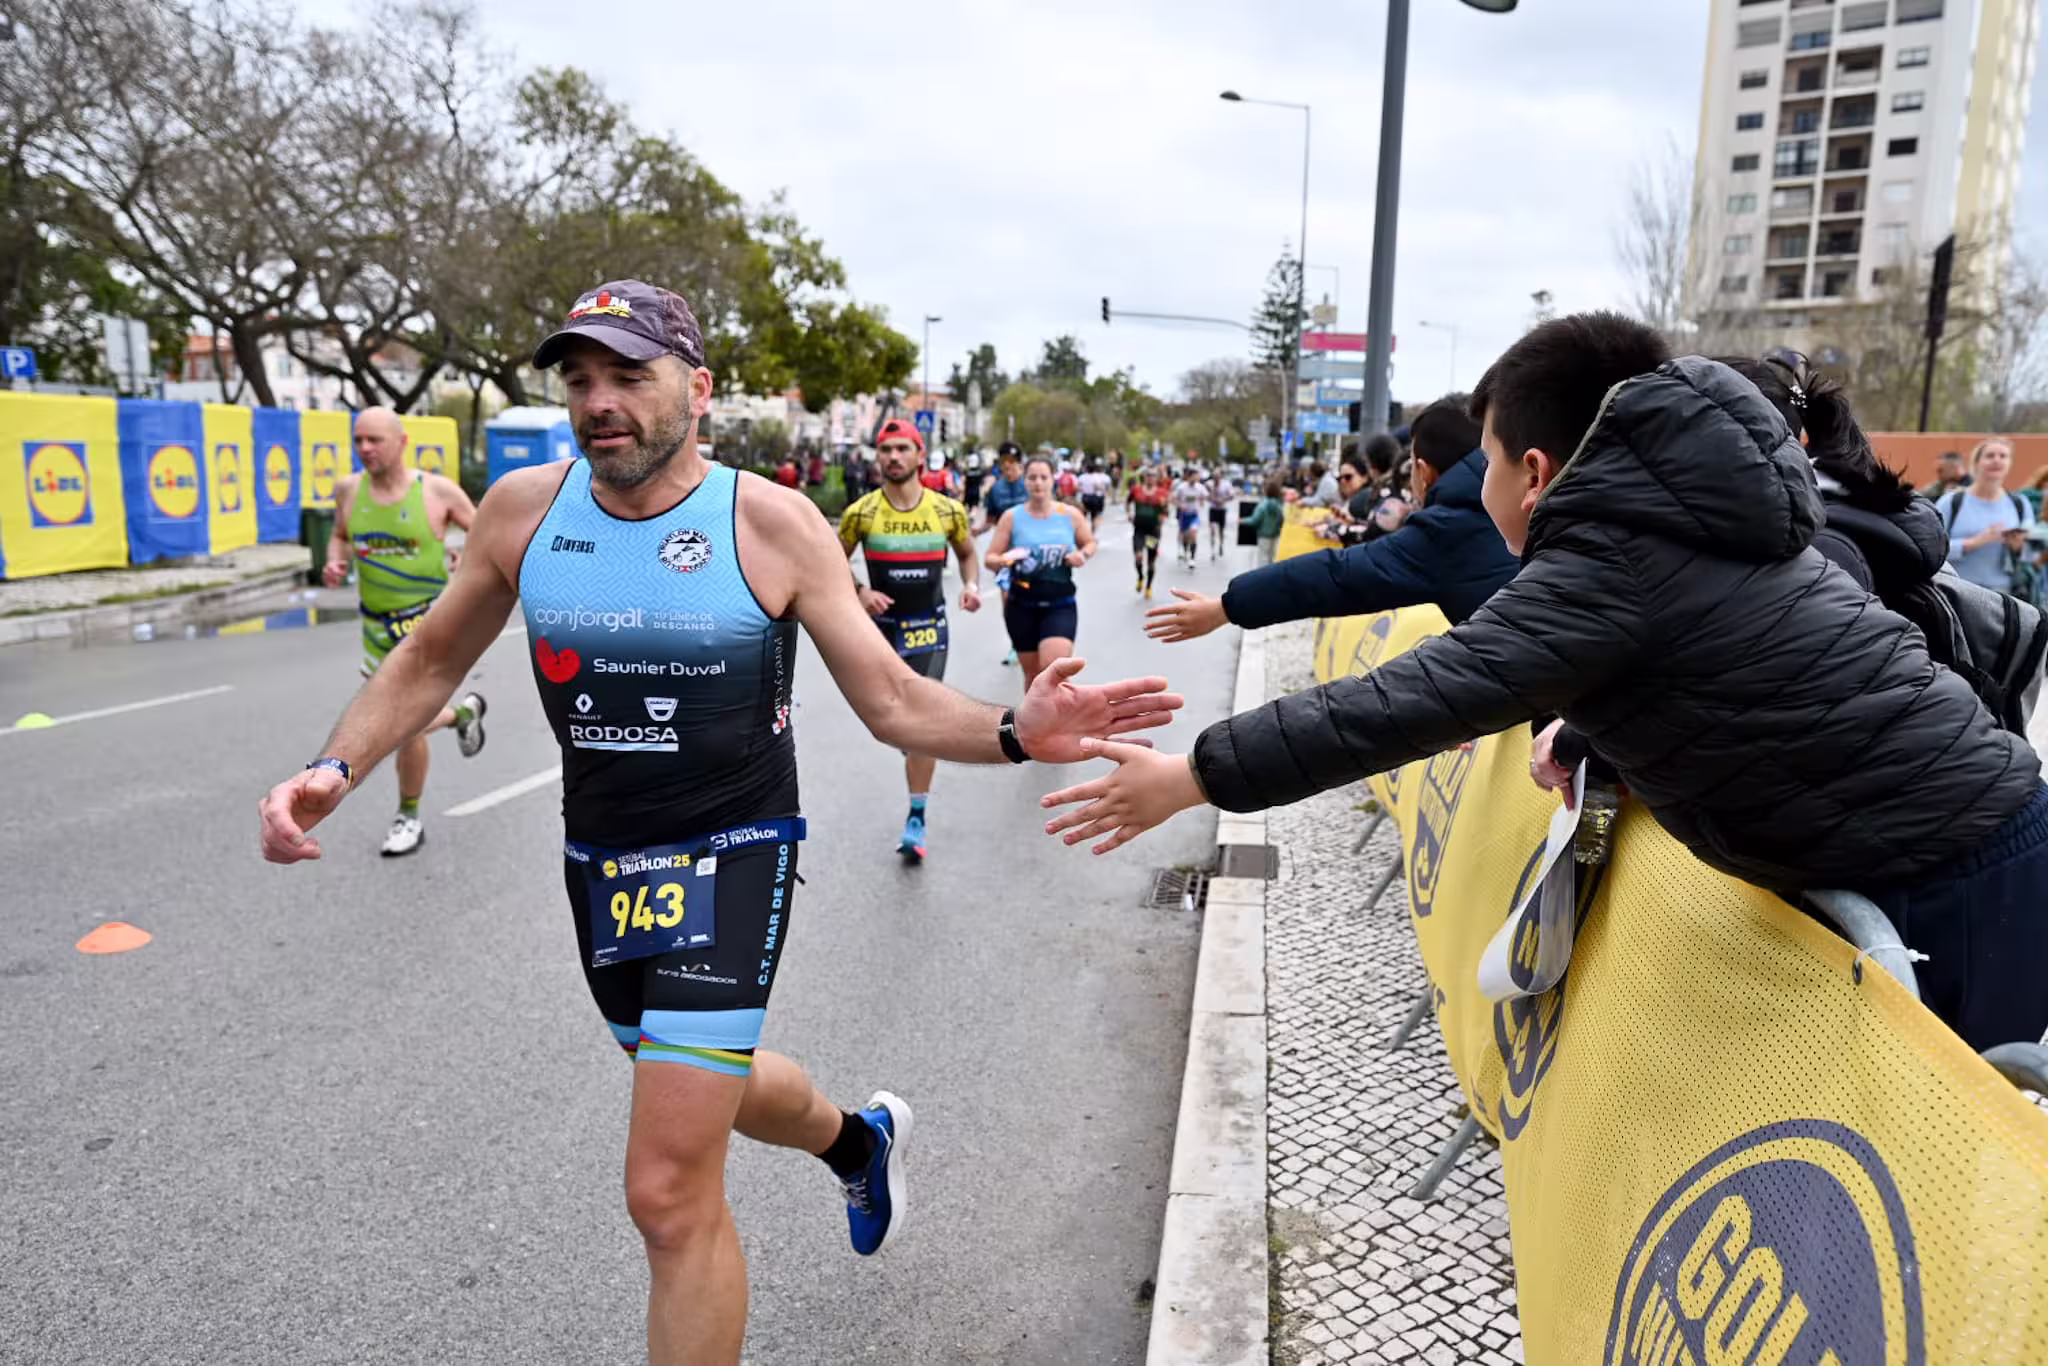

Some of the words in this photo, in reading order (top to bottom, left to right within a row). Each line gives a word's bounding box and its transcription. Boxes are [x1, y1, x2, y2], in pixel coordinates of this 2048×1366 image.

[6, 349, 29, 375] P
[535, 605, 644, 632] conforgal
[653, 622, 715, 631] DESCANSO
[904, 628, 938, 649] 320
[593, 658, 667, 675] Saunier
[670, 660, 726, 677] Duval
[570, 724, 679, 742] RODOSA
[775, 844, 789, 883] VIGO
[610, 882, 685, 938] 943
[772, 887, 784, 909] DE
[764, 913, 780, 950] MAR
